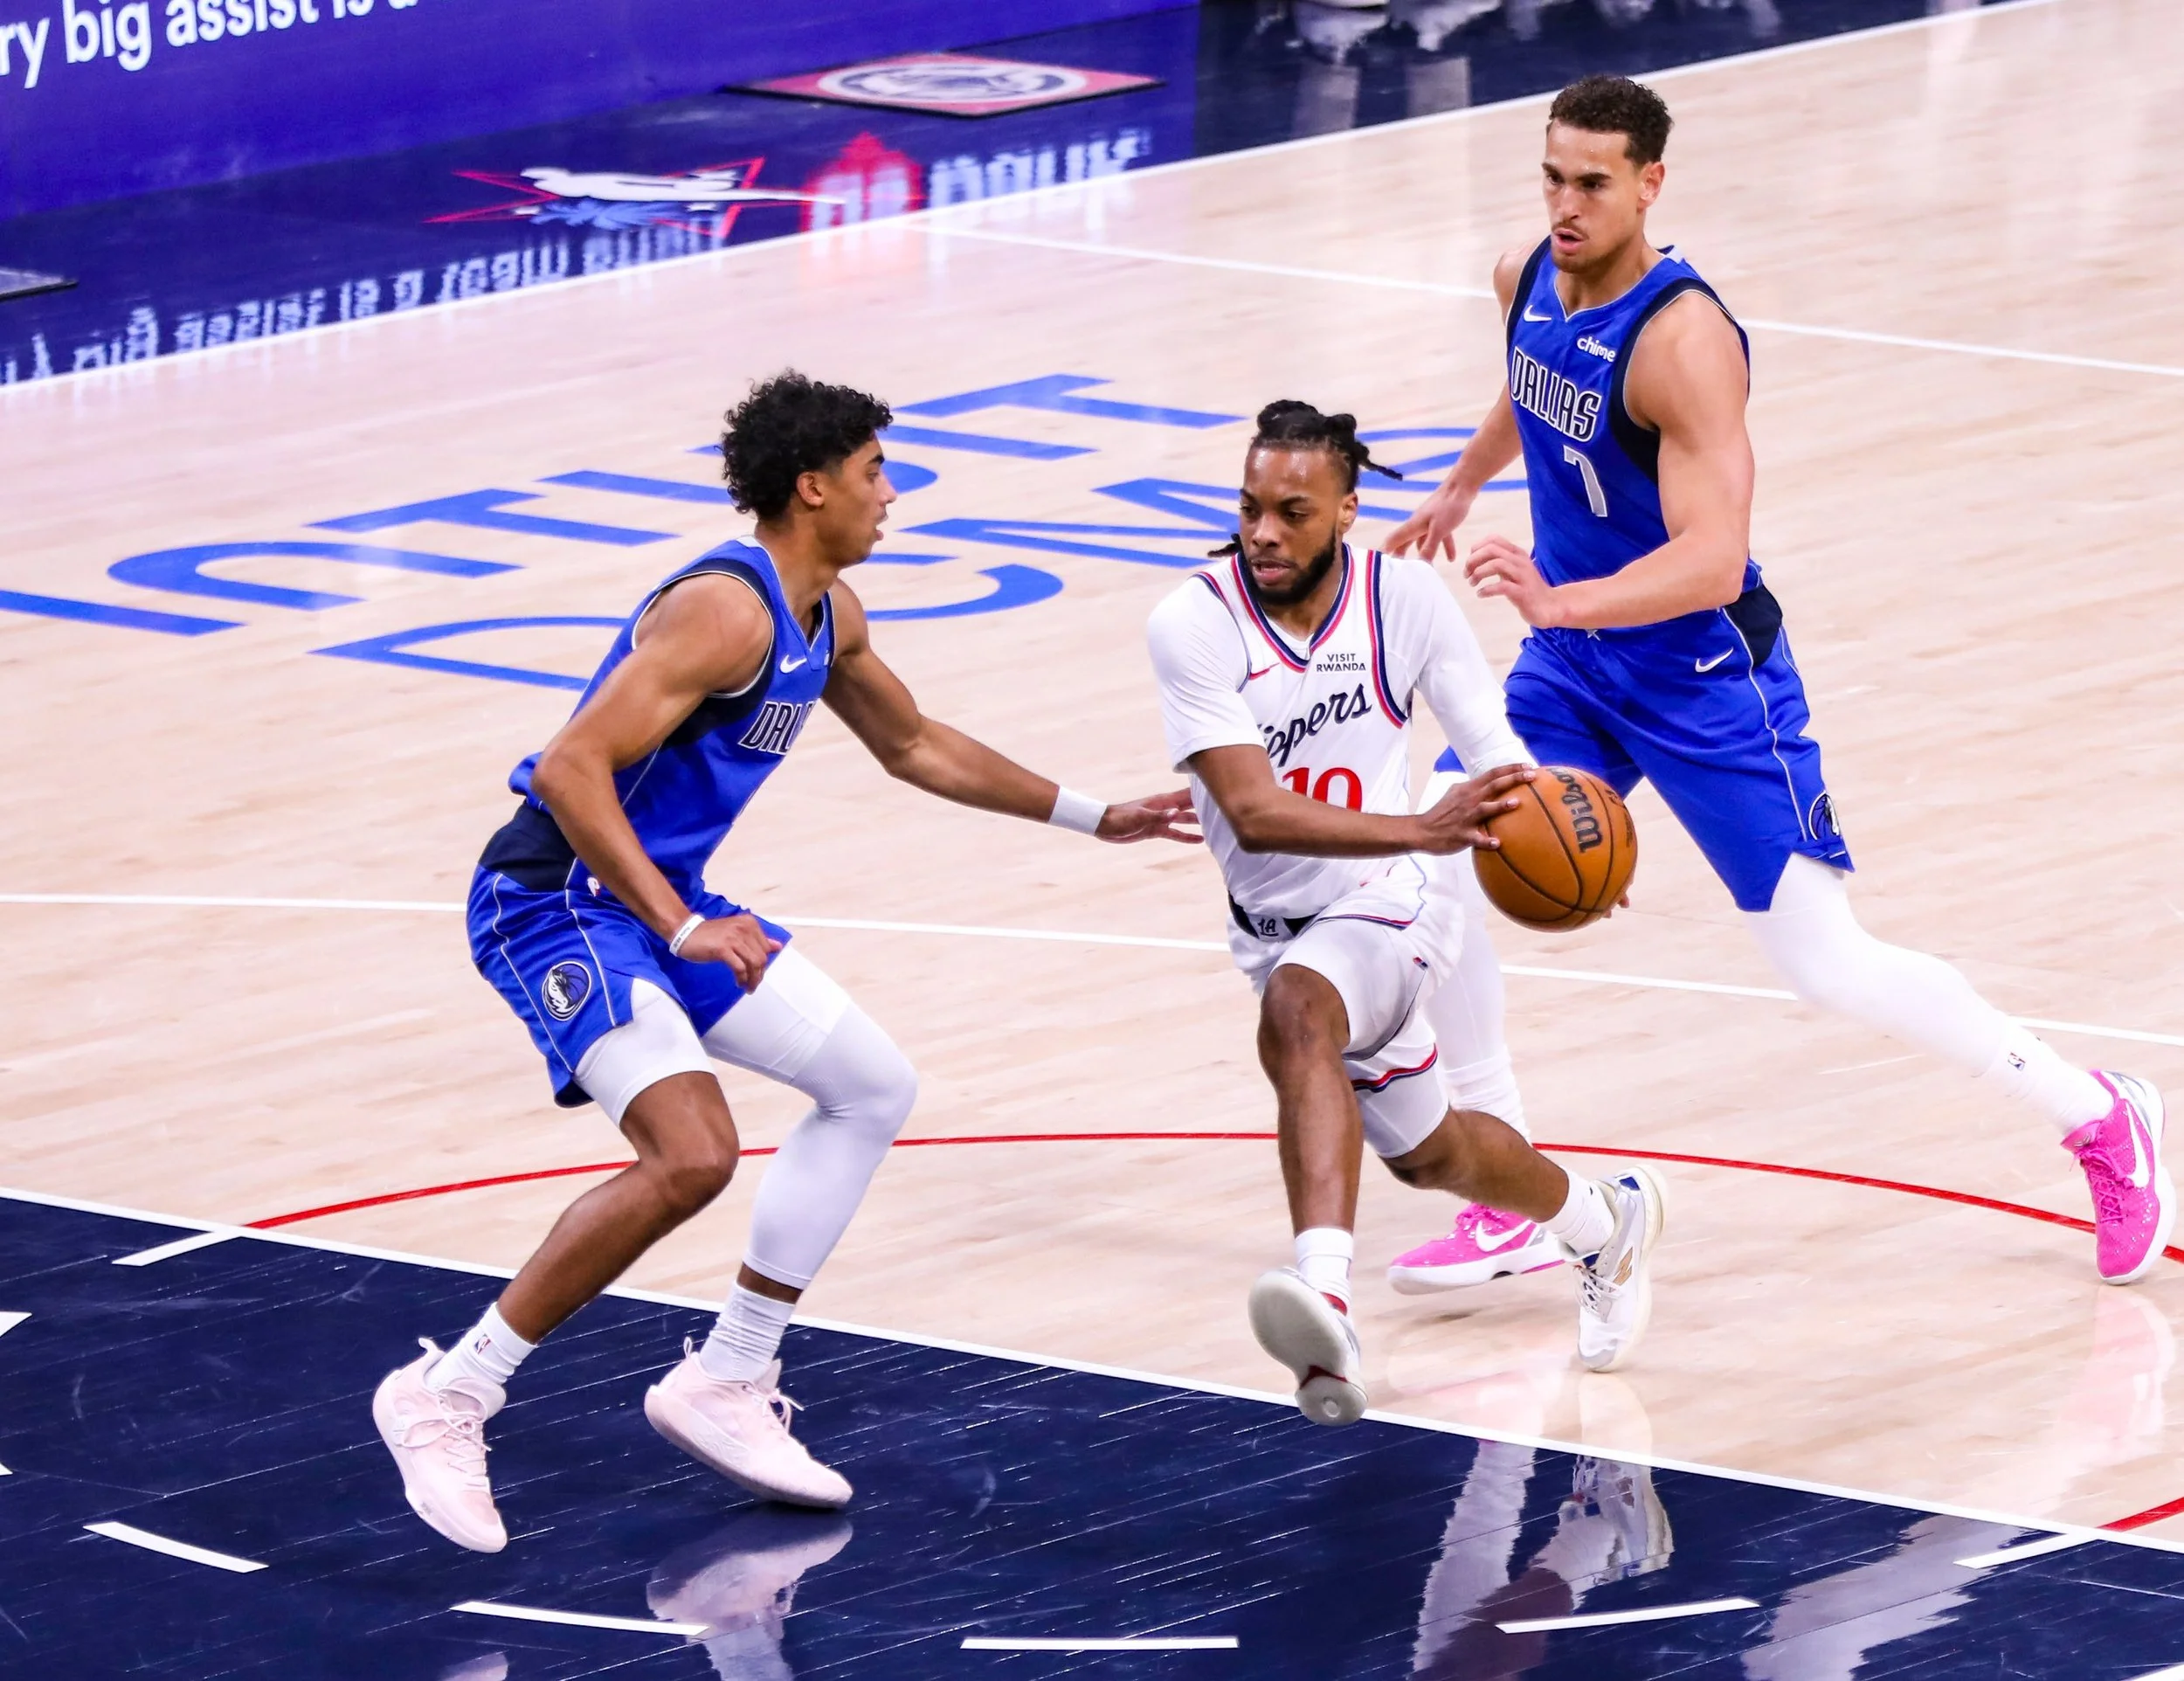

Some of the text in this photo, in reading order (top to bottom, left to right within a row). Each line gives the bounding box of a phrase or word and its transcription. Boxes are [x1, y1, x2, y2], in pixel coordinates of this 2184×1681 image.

[62, 0, 152, 72] big
[1577, 336, 1615, 363] chime
[1510, 346, 1602, 443] DALLAS
[1563, 445, 1607, 518] 7
[1317, 662, 1366, 672] RWANDA
[1327, 654, 1356, 662] VISIT
[1545, 767, 1603, 854] Wilson
